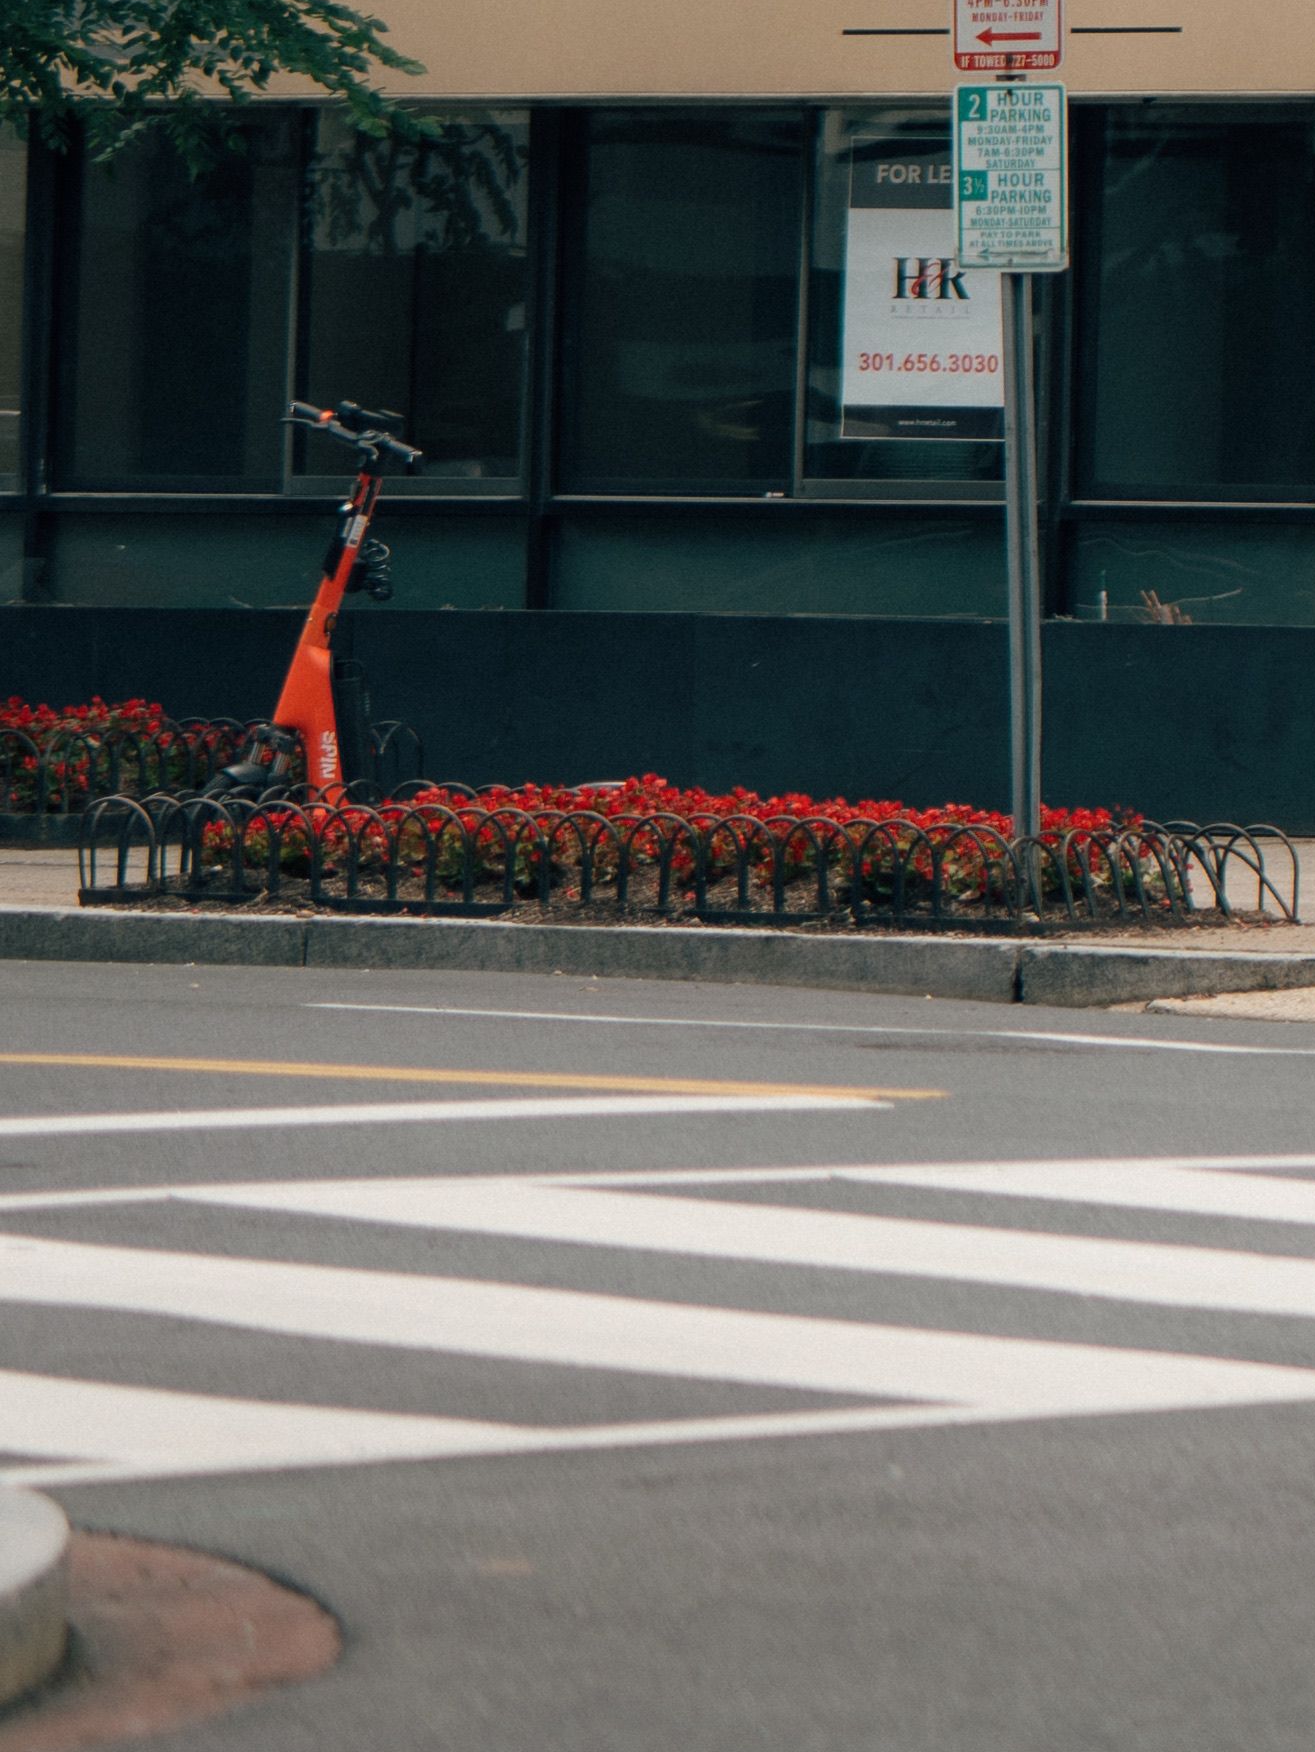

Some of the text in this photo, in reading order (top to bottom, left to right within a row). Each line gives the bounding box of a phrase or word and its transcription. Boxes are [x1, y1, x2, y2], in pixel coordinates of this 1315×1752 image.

[971, 11, 1044, 22] MONDAY-FRIDAY
[961, 55, 971, 68] IF
[974, 55, 1006, 67] TOWED
[968, 92, 1044, 118] 2 HOUR
[990, 108, 1051, 123] PARKING
[976, 124, 1045, 135] 9:30AM-4PM
[968, 136, 1053, 146] MONDAY-FRIDAY
[978, 147, 1045, 157] 7AM-6:30PM
[985, 159, 1036, 169] SATURDAY
[876, 164, 921, 184] FOR
[997, 172, 1045, 187] HOUR
[991, 189, 1052, 204] PARKING
[970, 217, 1052, 227] MONDAY-SATURDAY
[981, 230, 1040, 238] PAY TO PARK
[969, 240, 979, 248] AT
[981, 240, 996, 248] ALL
[1026, 239, 1053, 247] ABOVE
[890, 305, 970, 314] RETAIL
[858, 352, 999, 373] 301.656.3030
[320, 730, 338, 779] SPIN
